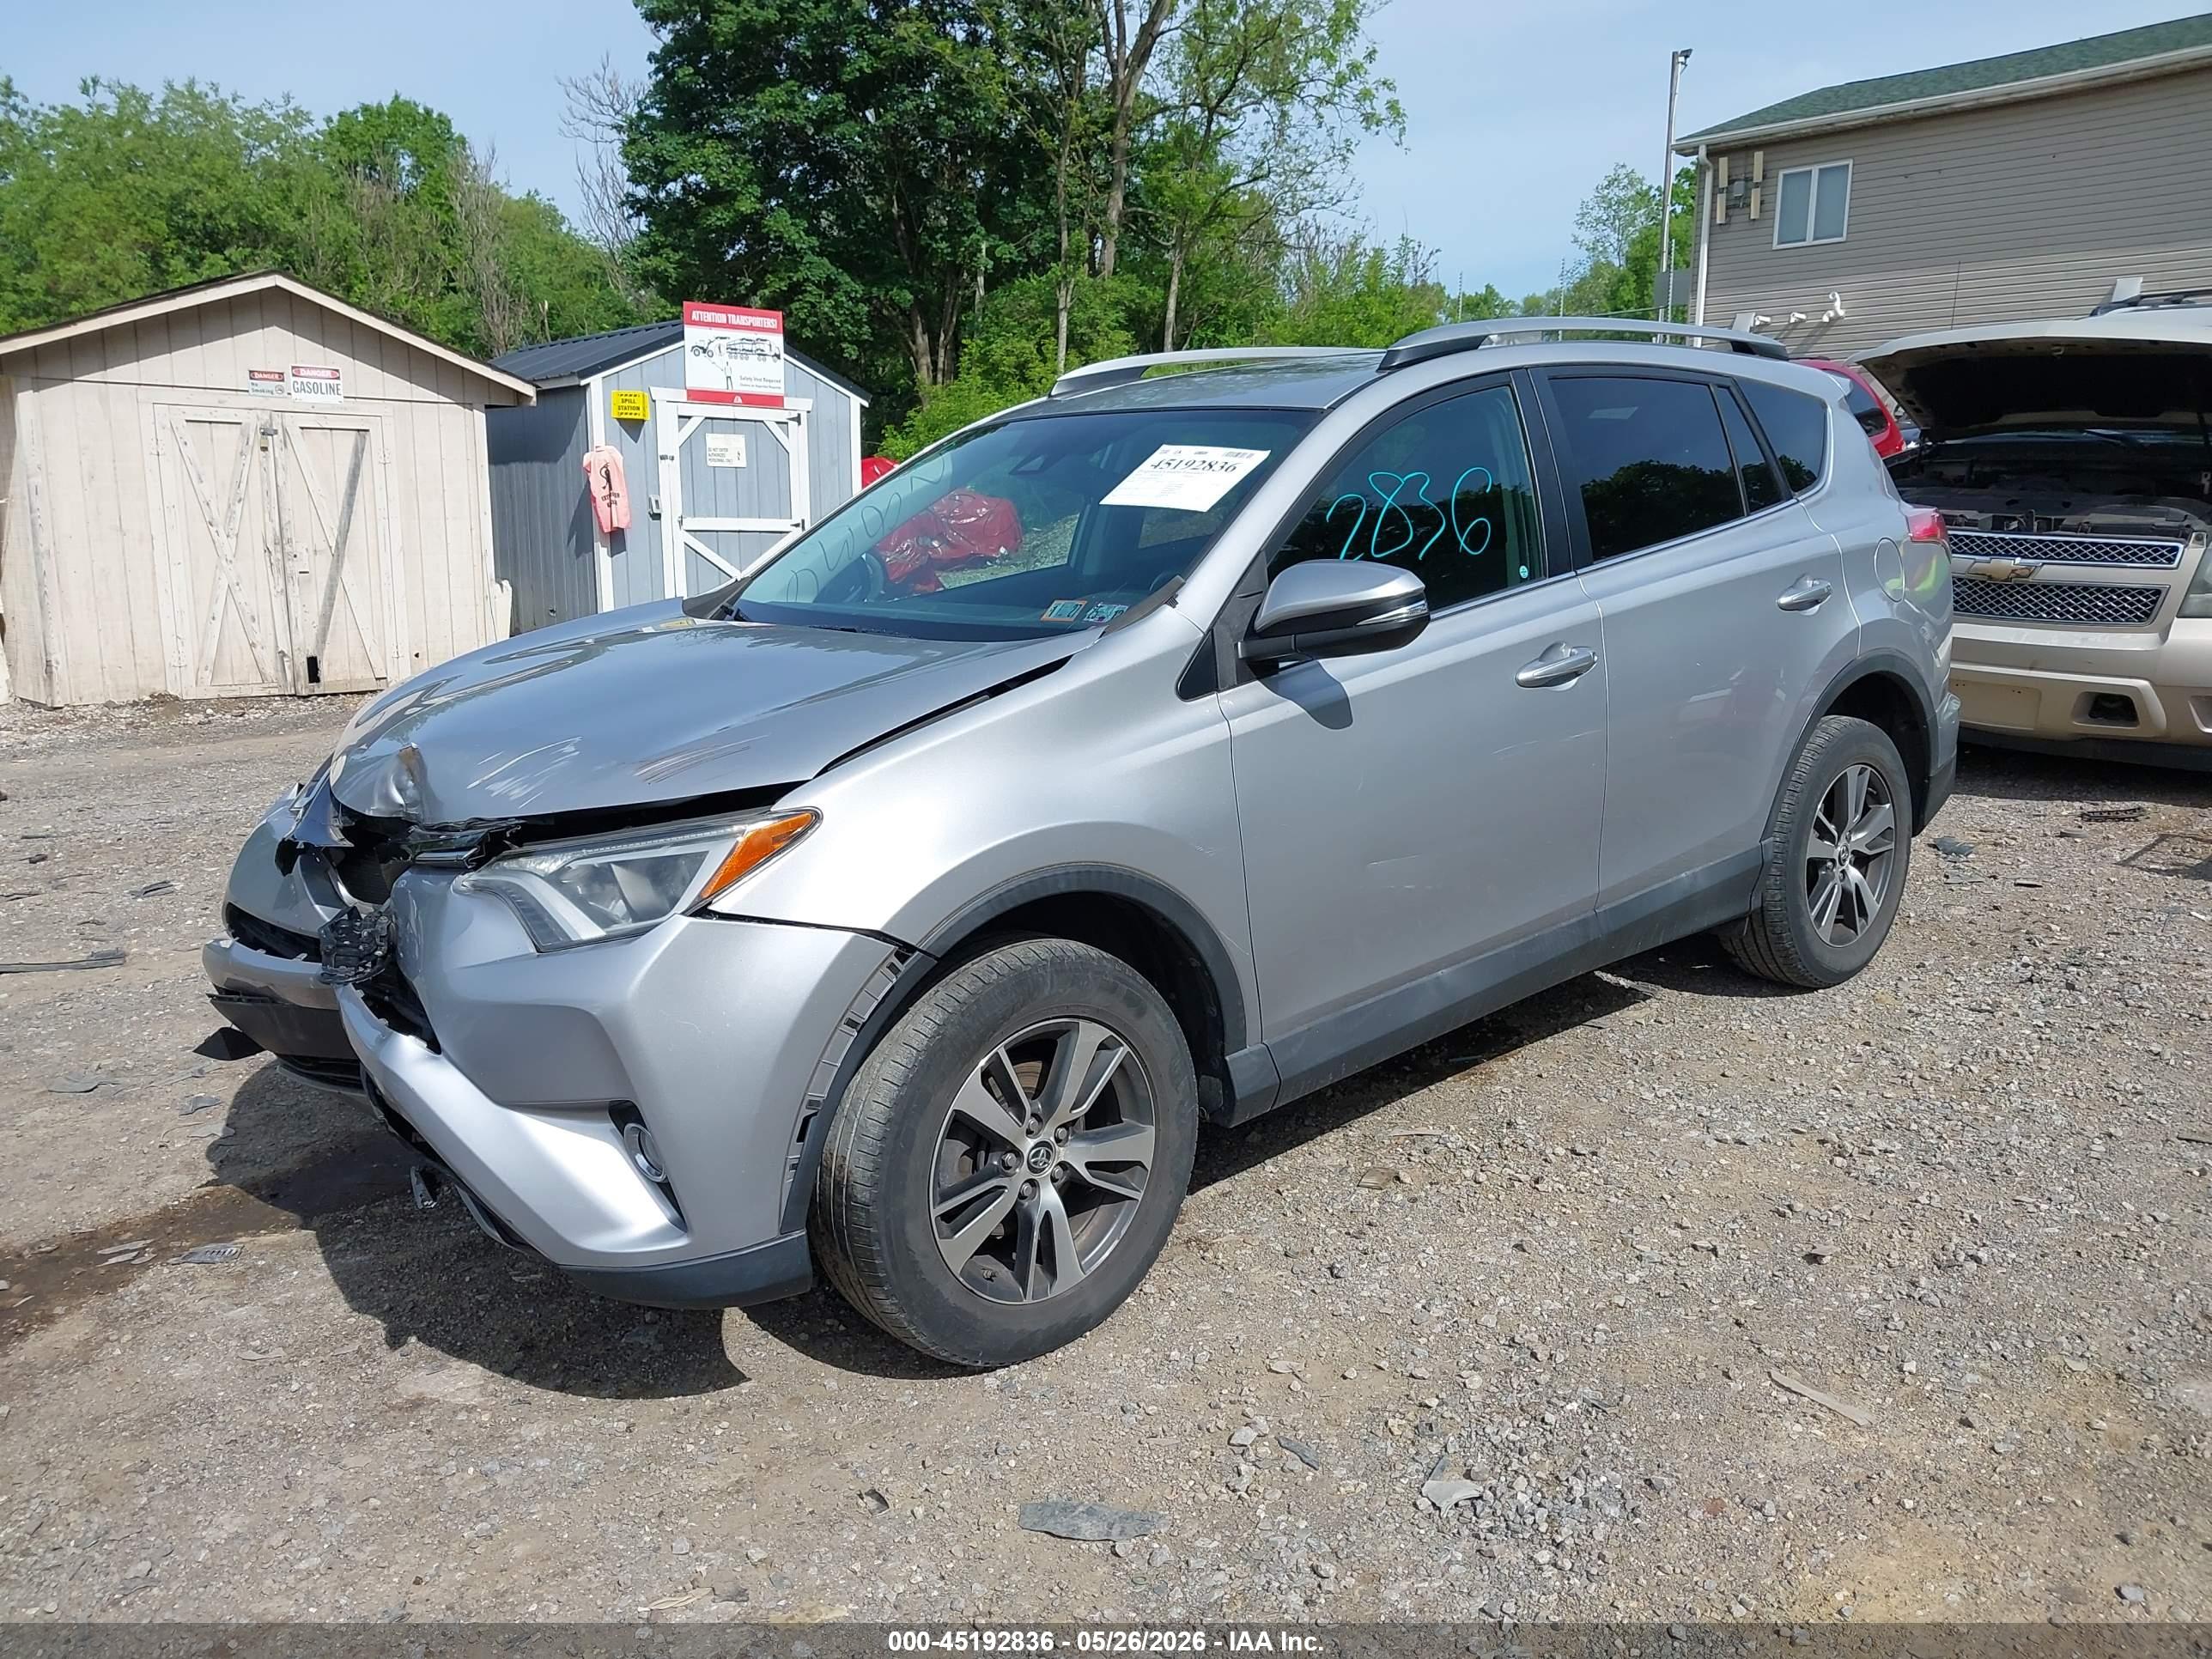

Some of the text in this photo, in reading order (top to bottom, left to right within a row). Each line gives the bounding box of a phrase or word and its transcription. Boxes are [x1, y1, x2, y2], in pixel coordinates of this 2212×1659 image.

[691, 309, 778, 329] ATTENTION TRANSPORTERS!
[254, 372, 279, 380] DANGER
[301, 368, 331, 379] DANGER
[292, 380, 342, 396] GASOLINE
[1151, 458, 1243, 473] 45192836
[1325, 465, 1493, 562] 2836
